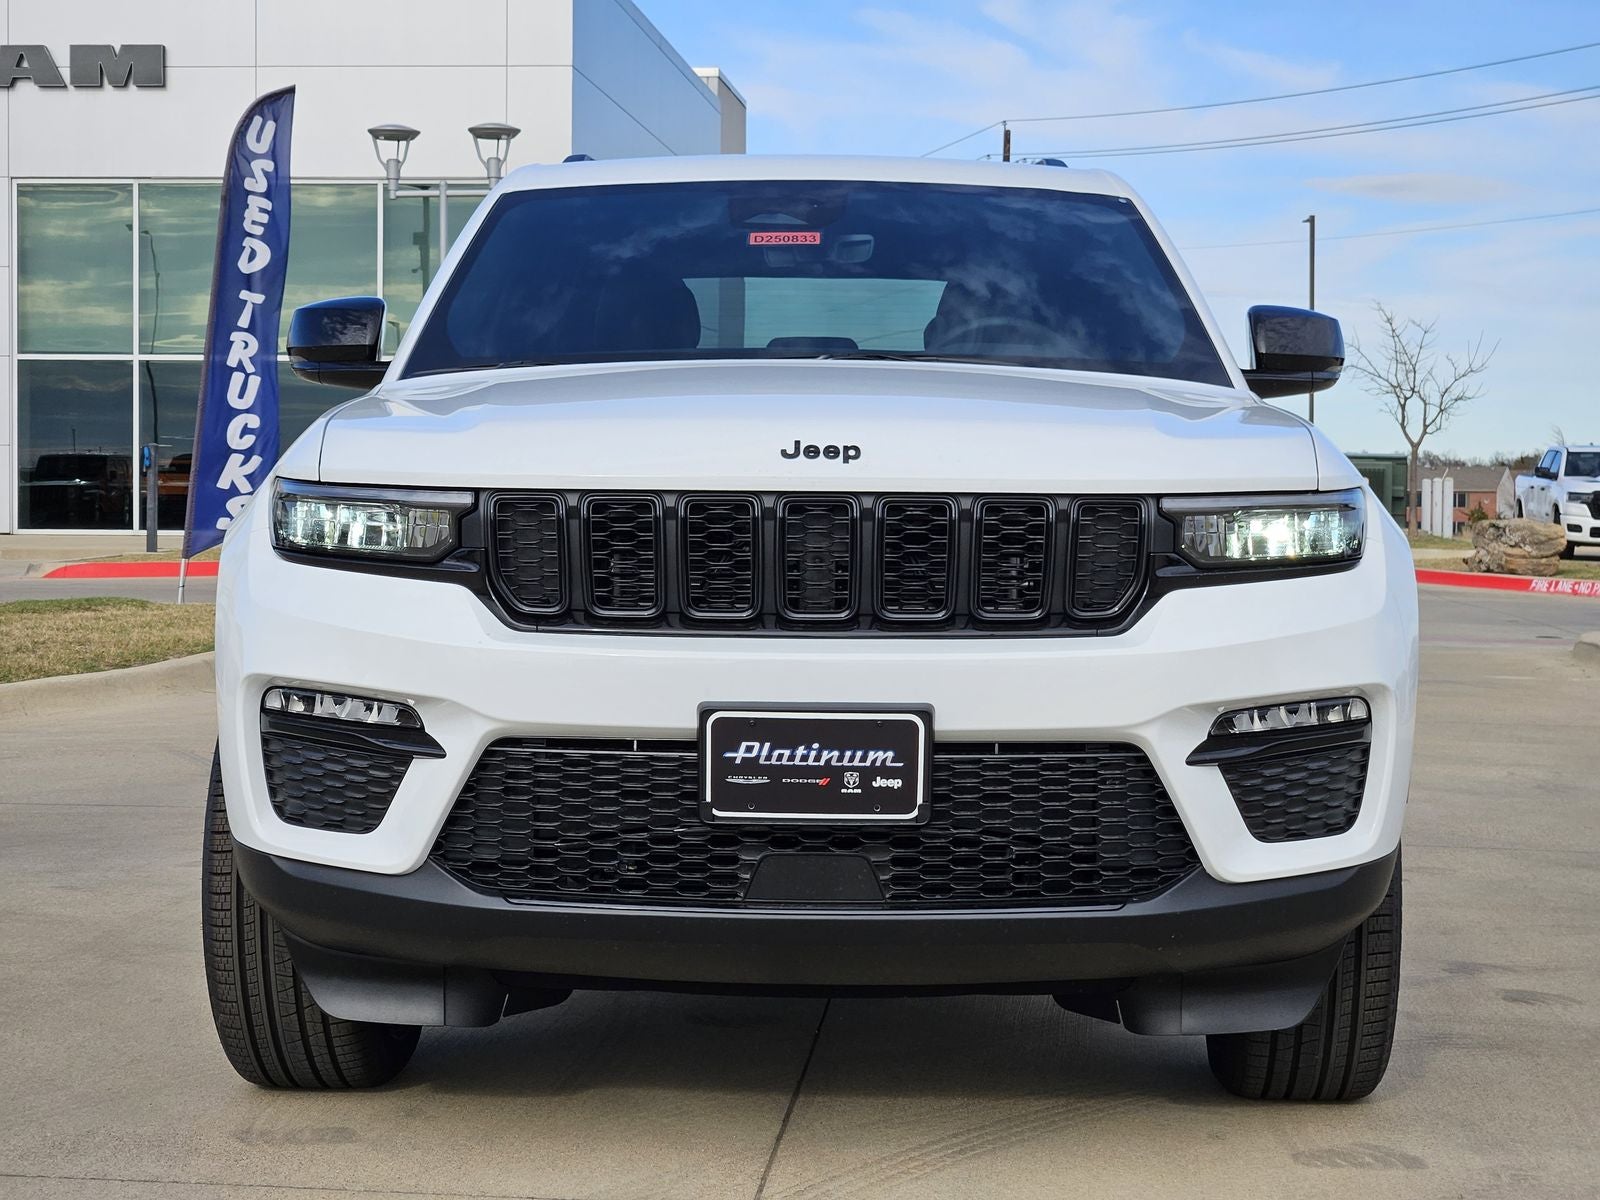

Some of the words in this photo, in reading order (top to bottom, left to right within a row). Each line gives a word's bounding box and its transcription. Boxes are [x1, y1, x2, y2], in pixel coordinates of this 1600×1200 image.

[237, 115, 276, 274] USED
[753, 234, 817, 243] D250833
[780, 440, 861, 464] Jeep
[722, 741, 905, 767] Platinum
[872, 776, 902, 789] Jeep
